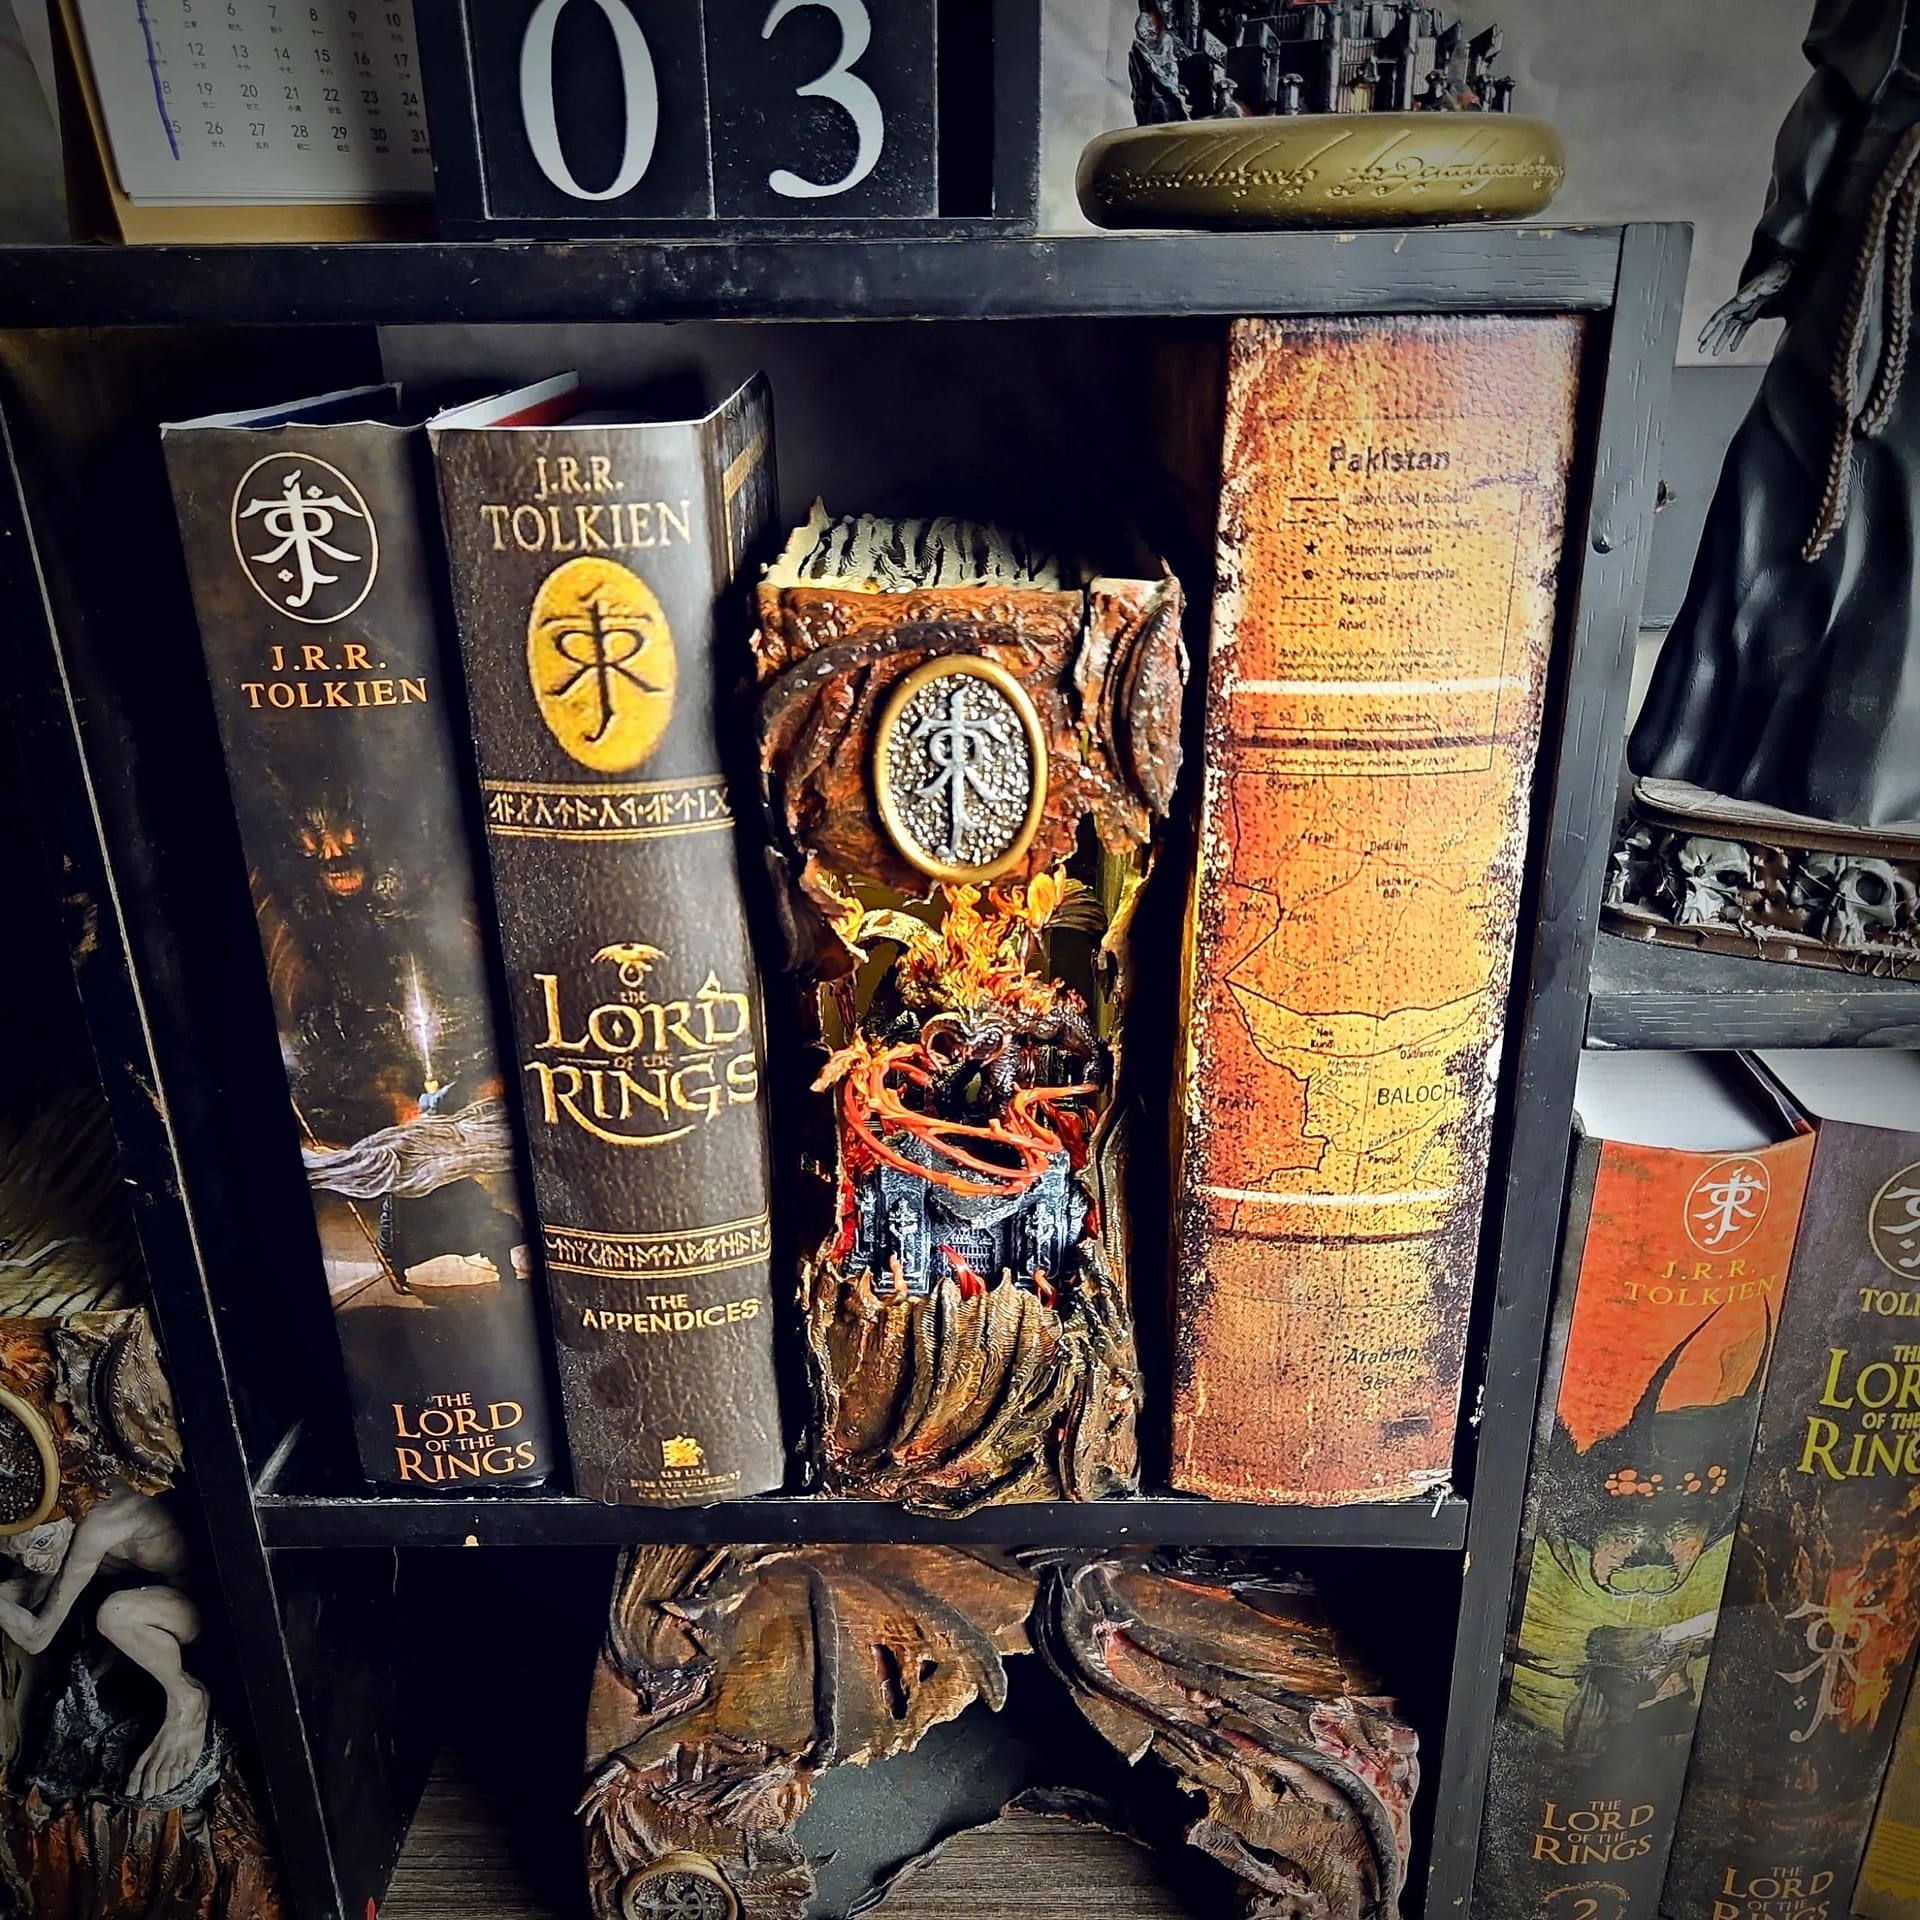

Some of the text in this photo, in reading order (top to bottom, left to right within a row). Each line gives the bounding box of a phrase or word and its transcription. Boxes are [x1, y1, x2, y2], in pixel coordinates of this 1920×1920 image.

[227, 3, 236, 16] 6
[267, 5, 277, 18] 7
[309, 8, 318, 21] 8
[348, 10, 357, 24] 9
[385, 13, 401, 27] 10
[188, 42, 205, 56] 12
[232, 44, 249, 58] 13
[274, 47, 290, 60] 14
[315, 48, 330, 62] 15
[353, 51, 370, 65] 16
[394, 53, 408, 67] 17
[197, 82, 213, 96] 19
[240, 84, 258, 98] 20
[283, 86, 299, 100] 21
[322, 88, 341, 102] 22
[361, 90, 379, 104] 23
[401, 92, 418, 106] 24
[205, 121, 224, 135] 26
[248, 122, 266, 137] 27
[291, 124, 309, 138] 28
[331, 126, 348, 140] 29
[370, 127, 387, 141] 30
[411, 129, 427, 143] 31
[1328, 445, 1450, 474] Pakistan
[534, 456, 625, 501] J.R.R.
[480, 501, 692, 552] TOLKIEN
[270, 643, 387, 673] J.R.R.
[240, 677, 428, 709] TOLKIEN
[533, 969, 750, 1053] LORD
[524, 1048, 759, 1146] RINGS
[1660, 1259, 1755, 1281] J.R.R.
[646, 1294, 689, 1310] THE
[1623, 1275, 1776, 1305] TOLKIEN
[582, 1298, 763, 1334] APPENDICES
[1343, 1346, 1419, 1365] Arabian
[1360, 1375, 1397, 1391] Sea
[432, 1392, 473, 1408] THE
[392, 1401, 524, 1439] LORD
[1862, 1412, 1887, 1429] OF
[425, 1435, 496, 1452] OF THE
[395, 1440, 536, 1483] RINGS
[1542, 1803, 1655, 1832] LORD
[1589, 1800, 1622, 1811] THE
[1567, 1831, 1628, 1844] OF THE
[1531, 1834, 1653, 1866] RINGS
[1721, 1867, 1835, 1899] LORD
[1771, 1866, 1804, 1878] THE
[1573, 1899, 1599, 1920] 2
[1777, 1899, 1808, 1911] THE
